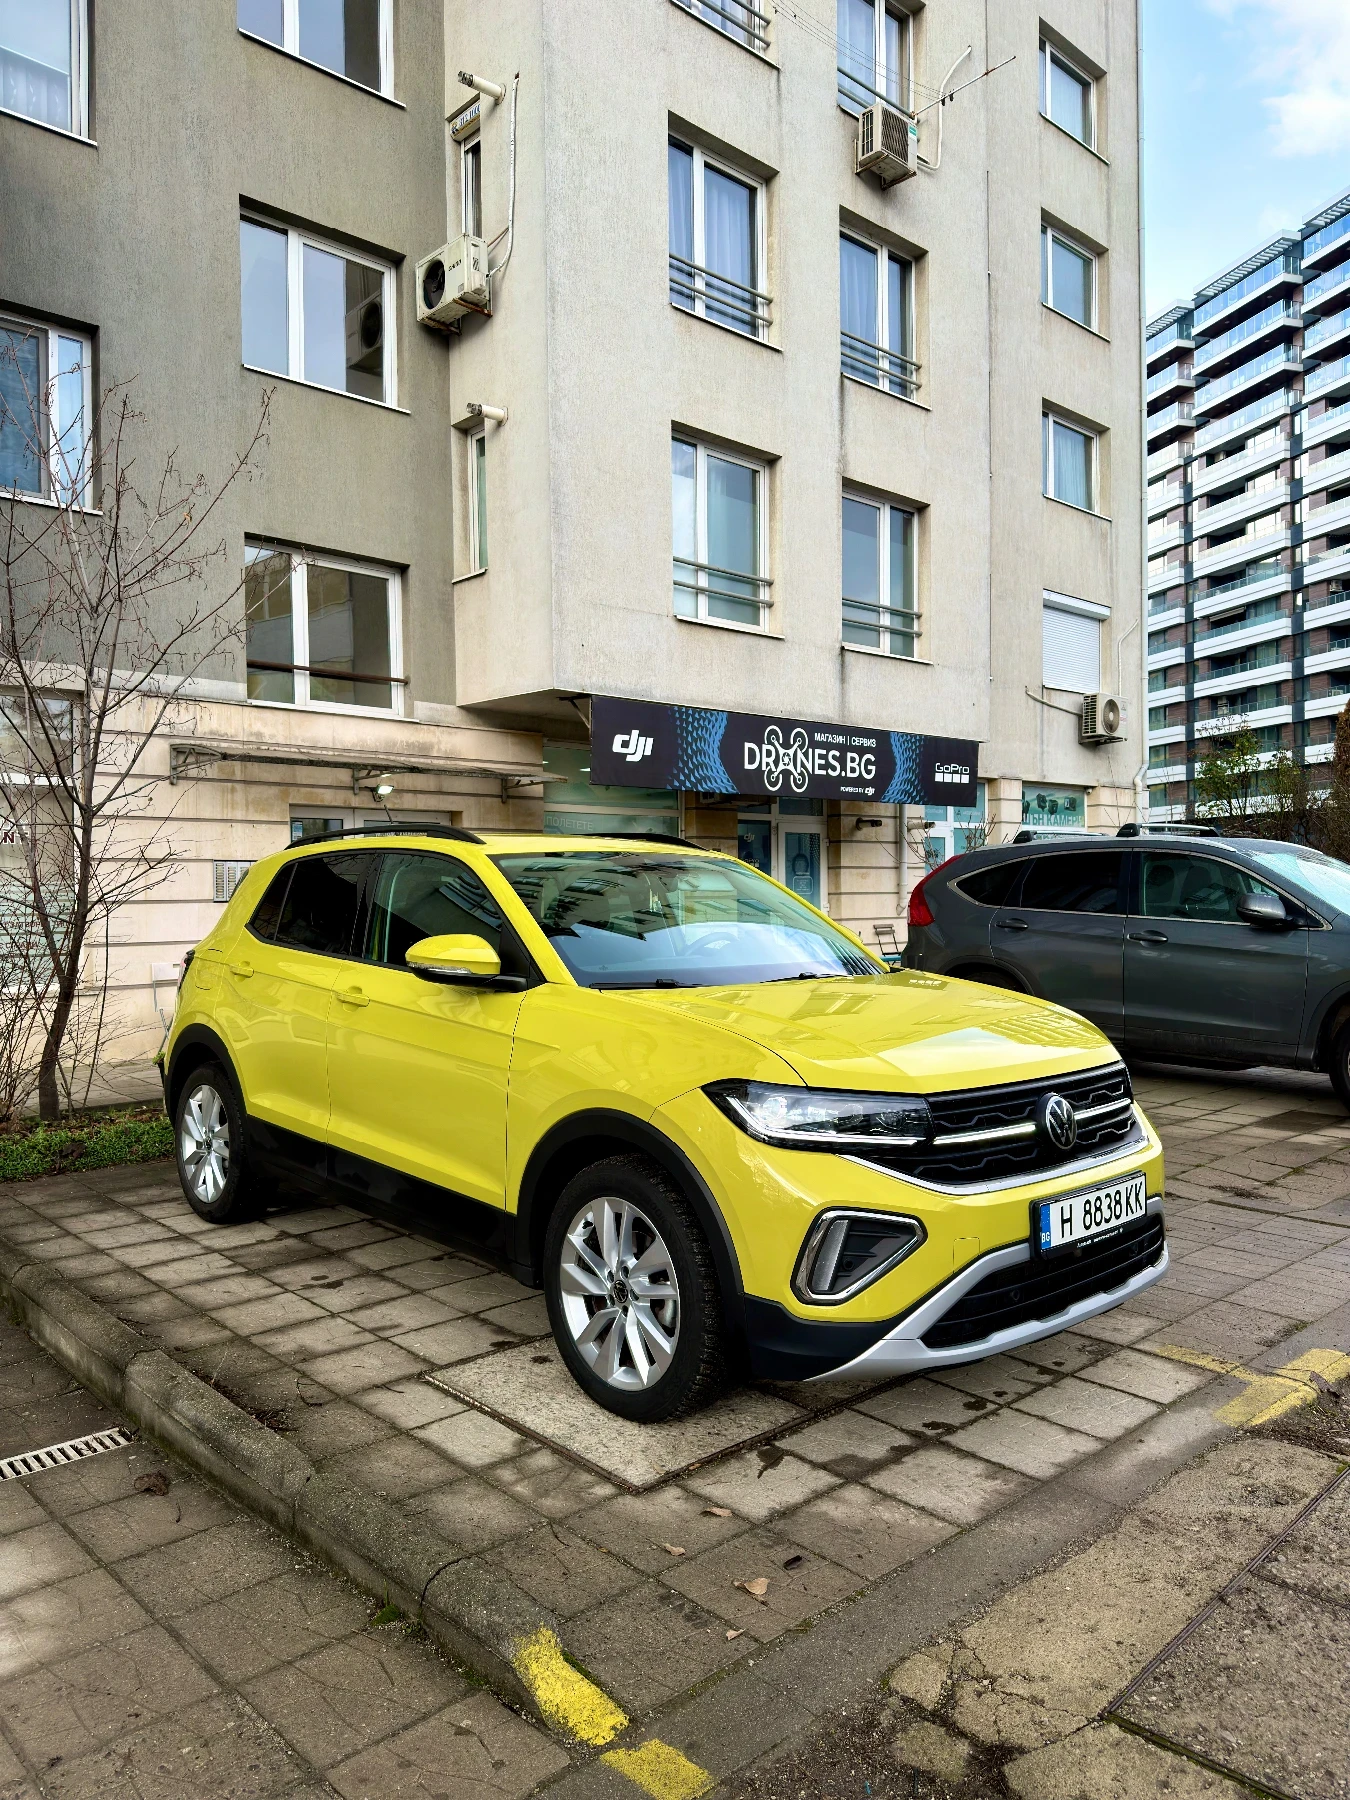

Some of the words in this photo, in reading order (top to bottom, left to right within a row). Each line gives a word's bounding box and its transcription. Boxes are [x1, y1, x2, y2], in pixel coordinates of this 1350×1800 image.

[814, 732, 846, 744] МАГАЗИН
[851, 736, 877, 748] СЕРВИЗ
[935, 762, 970, 774] GoPro
[546, 816, 594, 831] ПОЛЕТЕТЕ
[1041, 1231, 1051, 1244] BG
